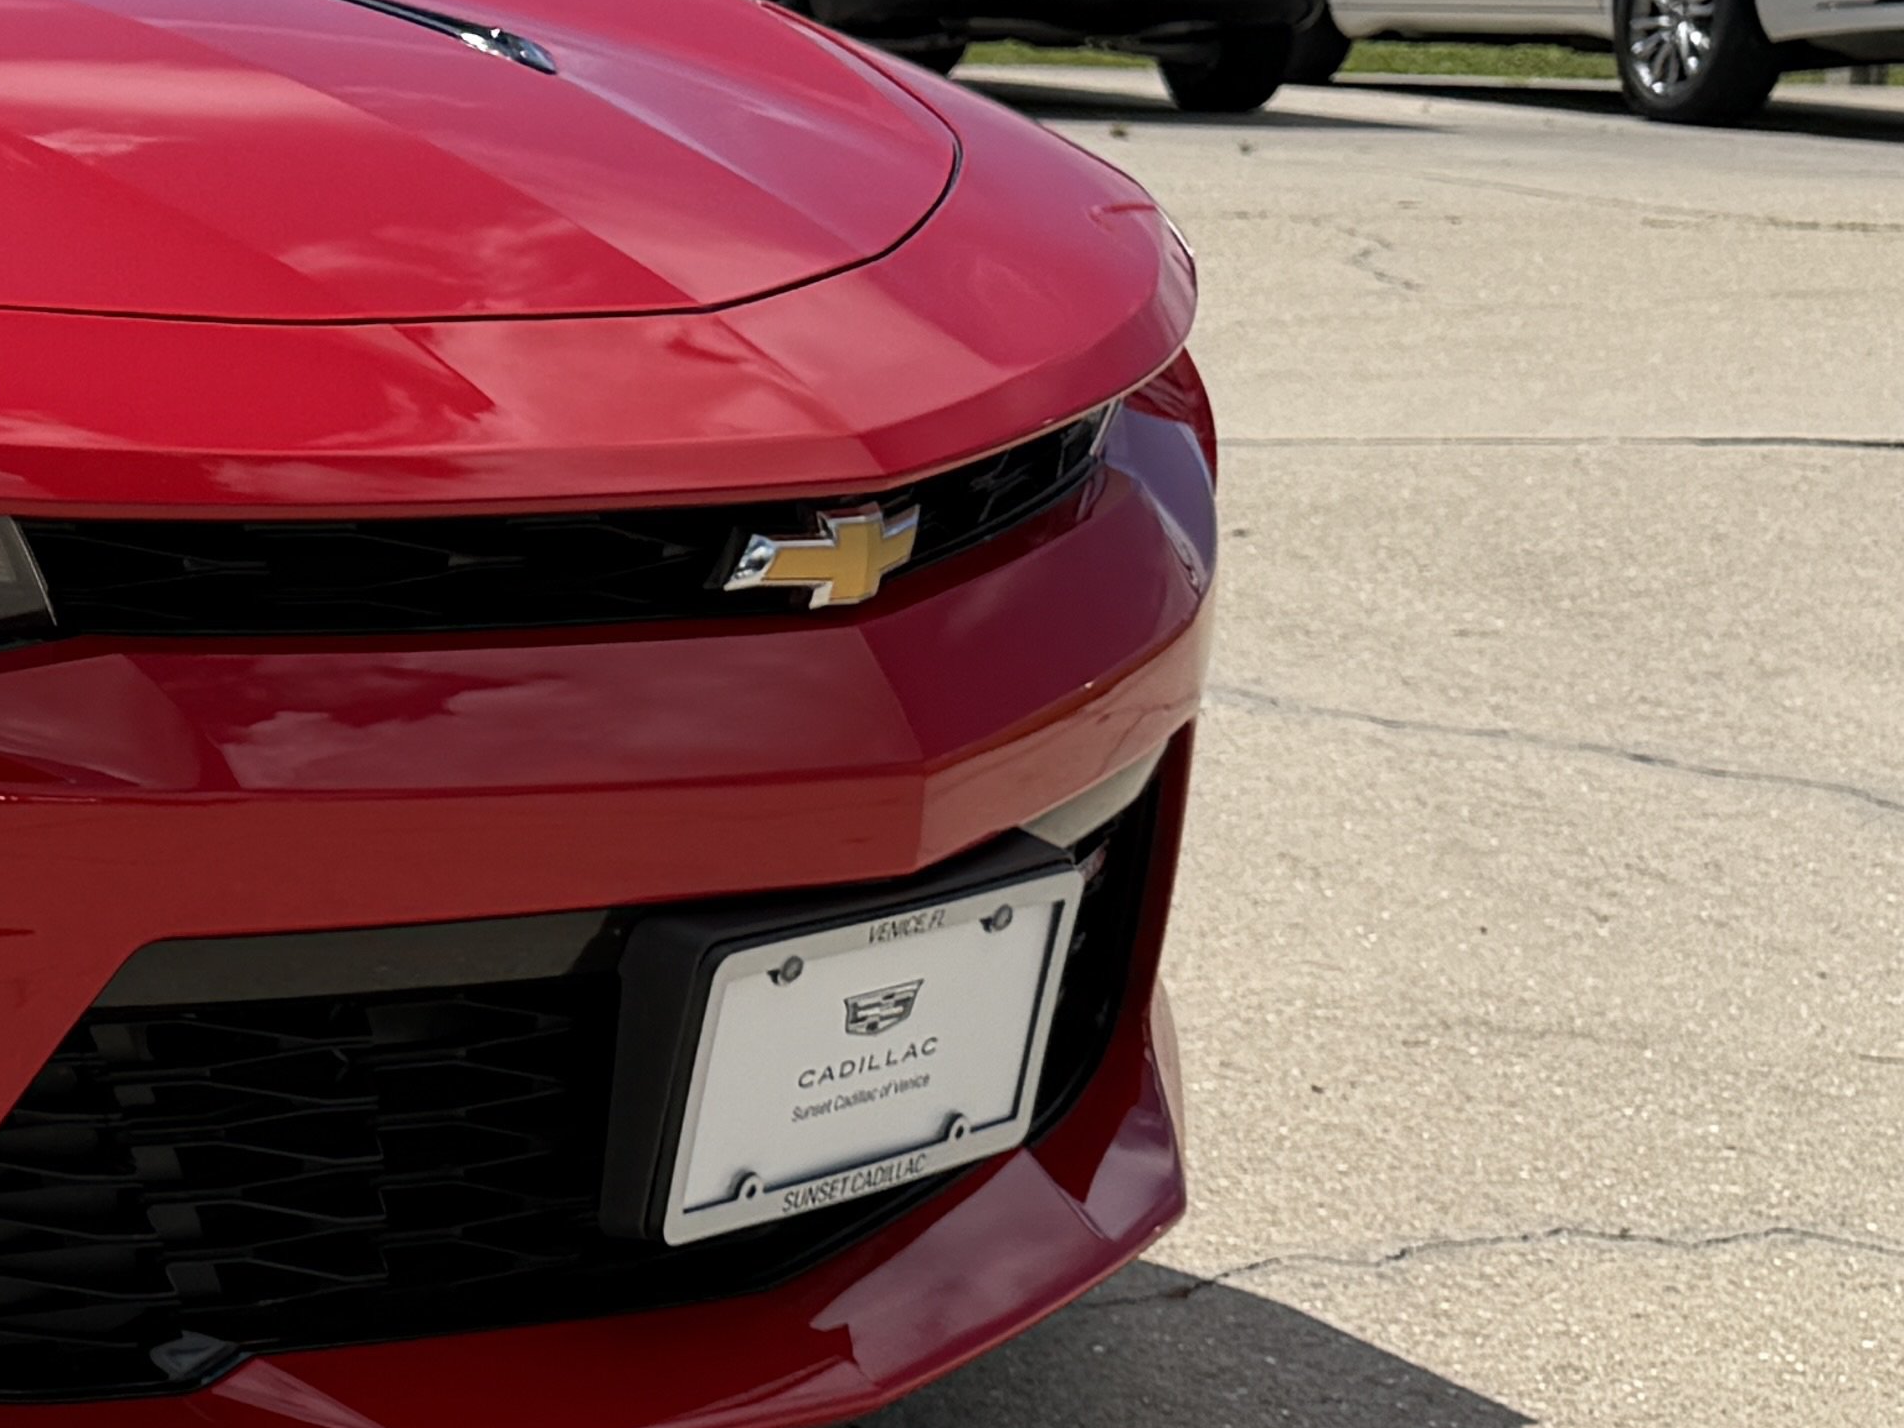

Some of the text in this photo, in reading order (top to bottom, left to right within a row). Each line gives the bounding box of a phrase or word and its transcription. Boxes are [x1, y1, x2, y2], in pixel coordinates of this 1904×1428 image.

[798, 1037, 938, 1088] CADILLAC
[782, 1153, 927, 1213] SUNSET CADILLAC
